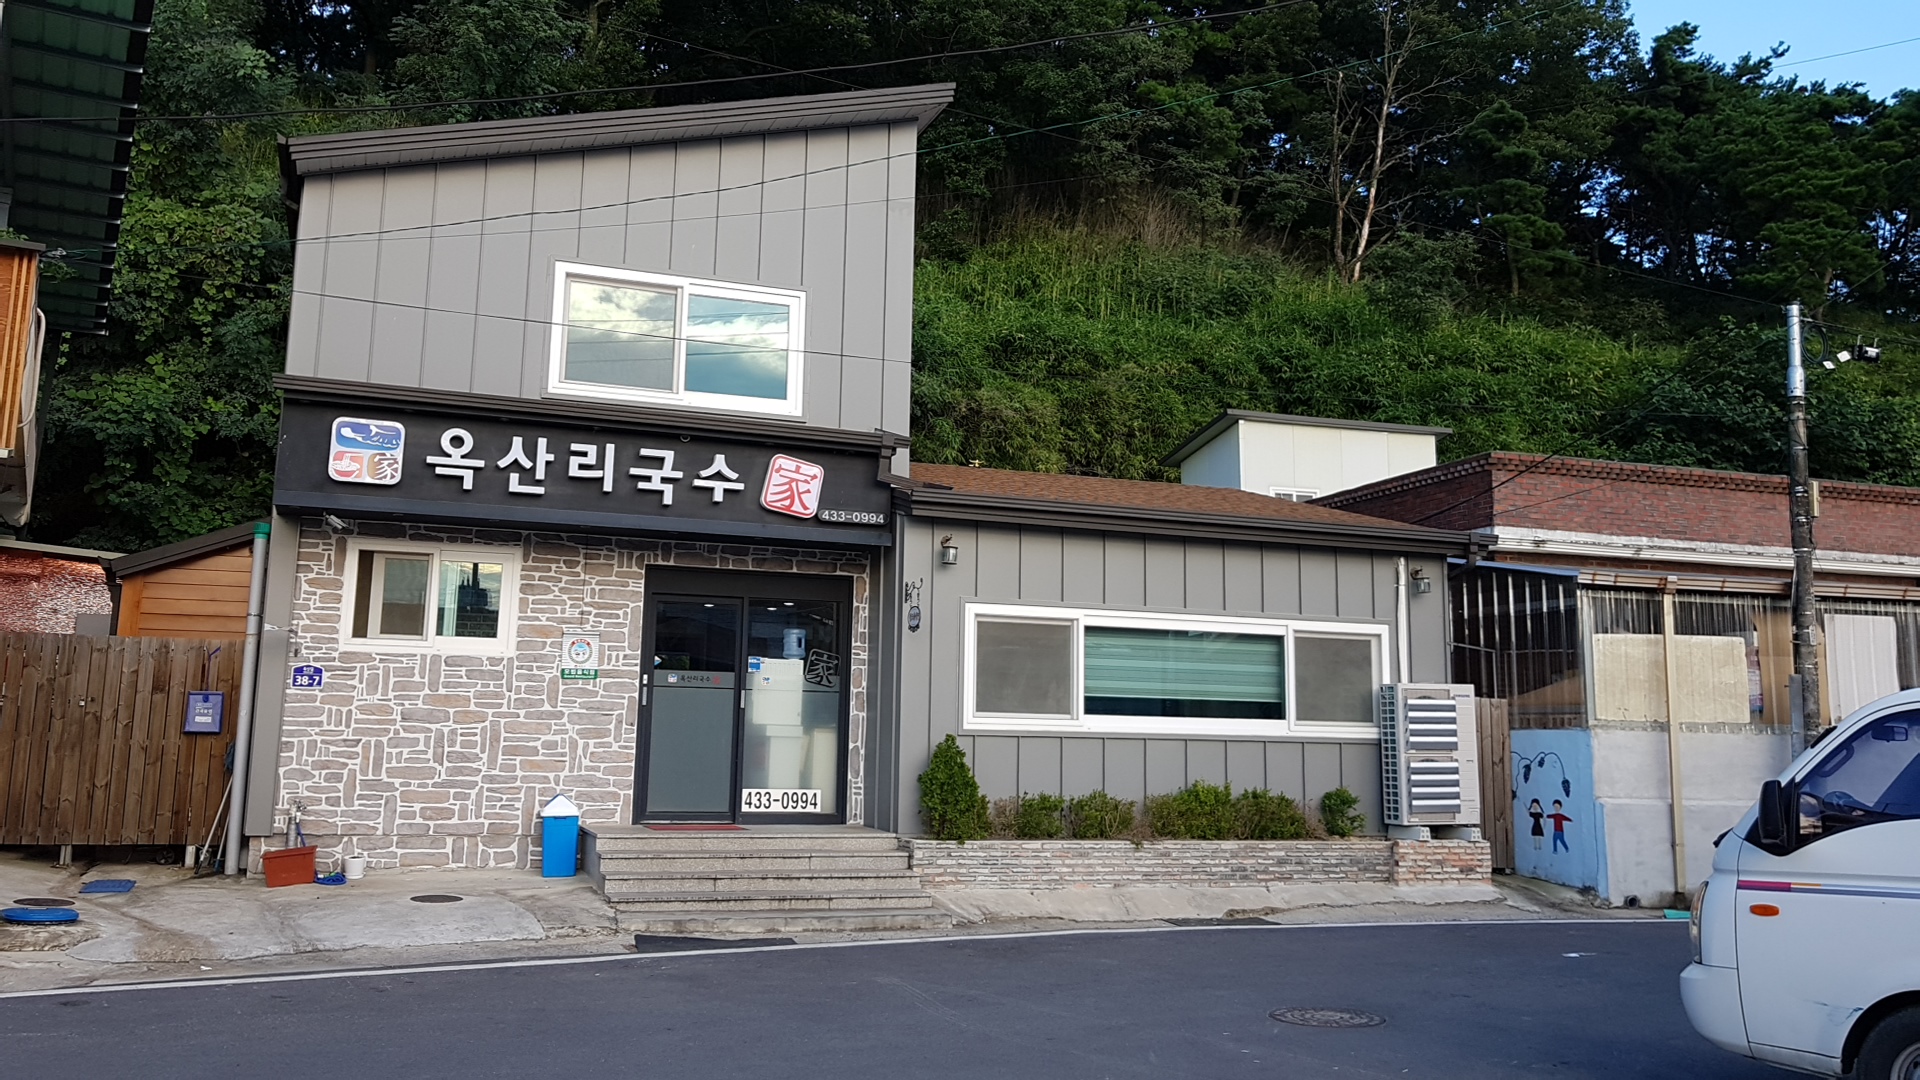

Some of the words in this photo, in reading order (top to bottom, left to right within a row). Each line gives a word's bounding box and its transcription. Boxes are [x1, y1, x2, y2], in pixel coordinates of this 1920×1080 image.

[425, 427, 745, 505] 옥산리국수
[767, 464, 818, 512] 家
[821, 509, 884, 523] 433-0994
[807, 653, 838, 684] 家
[294, 675, 320, 686] 38-7
[681, 674, 711, 682] 옥산리국수
[744, 791, 818, 809] 433-0994
